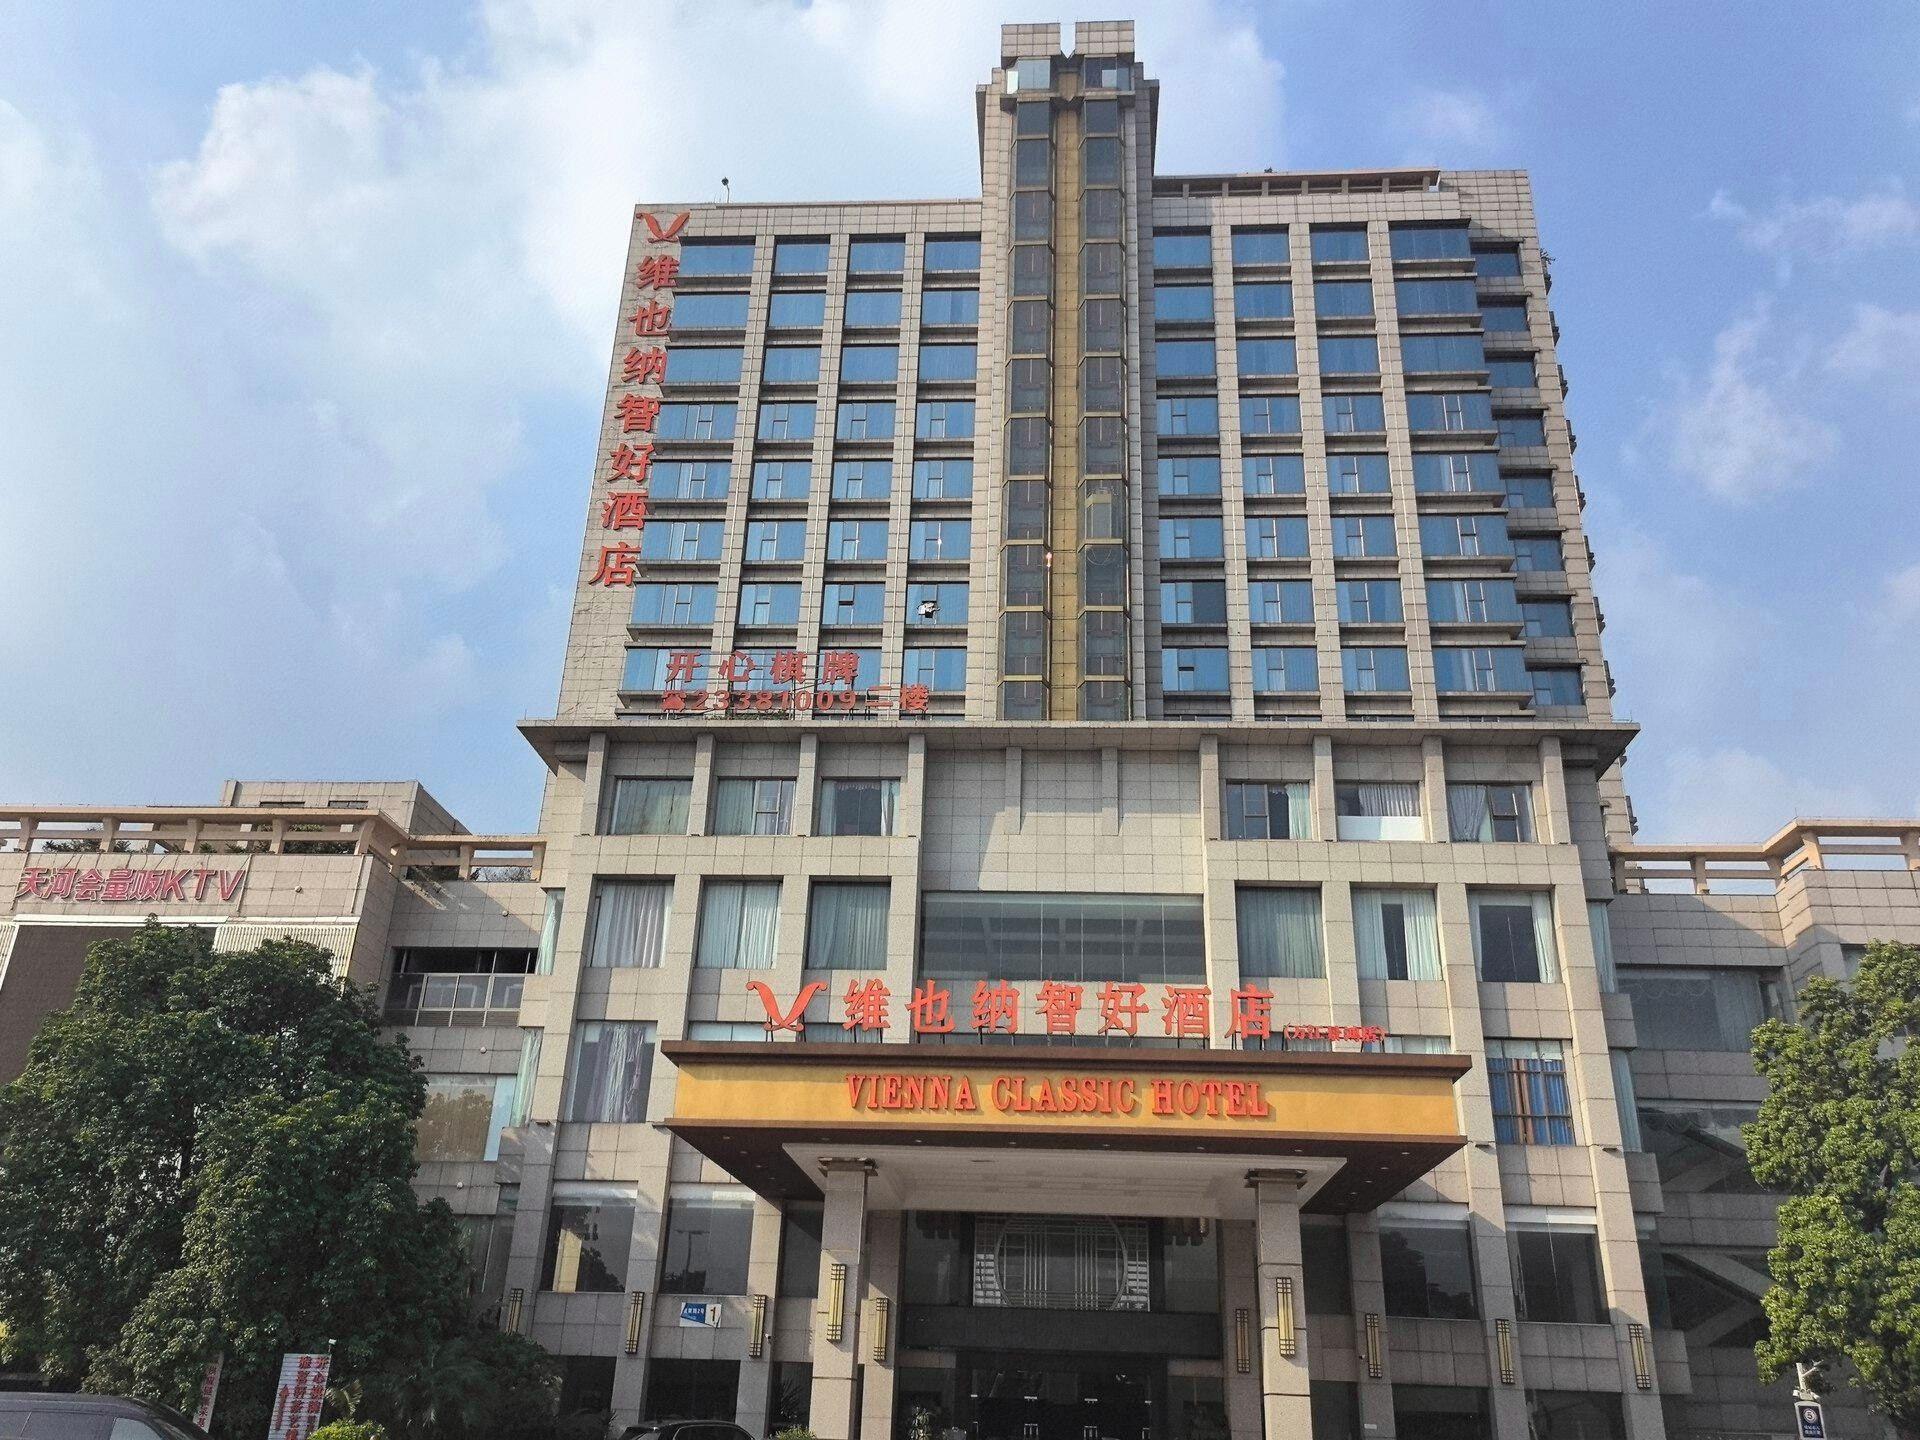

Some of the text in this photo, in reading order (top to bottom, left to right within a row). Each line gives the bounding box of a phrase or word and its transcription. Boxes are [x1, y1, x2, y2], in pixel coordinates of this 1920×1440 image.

[589, 255, 680, 587] 维也纳智好酒店
[665, 651, 861, 684] 开心棋牌
[16, 867, 246, 900] 天河会量贩KTV
[842, 978, 1275, 1040] 维也纳智好酒店
[845, 1074, 1270, 1117] VIENNA CLASSIC HOTEL
